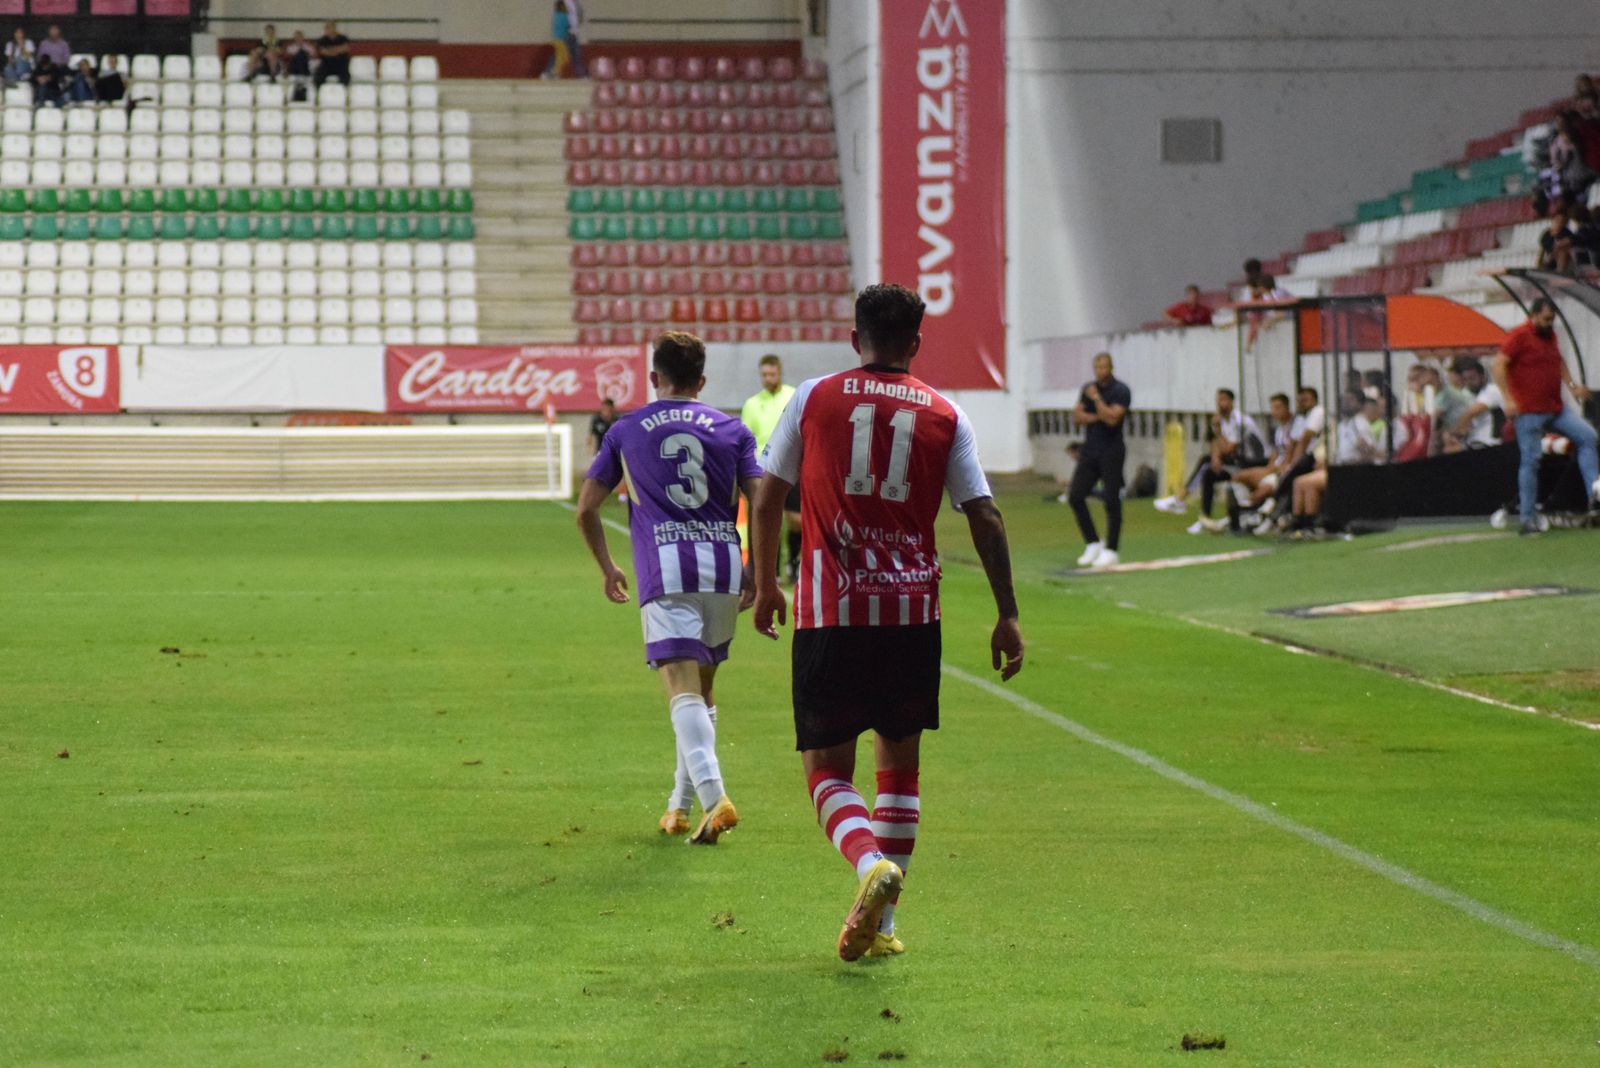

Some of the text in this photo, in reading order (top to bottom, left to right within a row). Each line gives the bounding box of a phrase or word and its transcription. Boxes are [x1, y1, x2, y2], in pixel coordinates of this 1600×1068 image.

[917, 45, 955, 317] avanza
[76, 355, 95, 387] 8
[398, 351, 583, 409] Cardiza
[843, 378, 932, 406] EL HADDADI
[640, 409, 715, 432] DIEGO M.
[844, 403, 917, 502] 11
[660, 433, 709, 509] 3
[653, 520, 736, 534] HERBALIFE
[655, 531, 737, 545] NUTRITION
[855, 566, 932, 583] Pronatal
[856, 584, 896, 593] Medical
